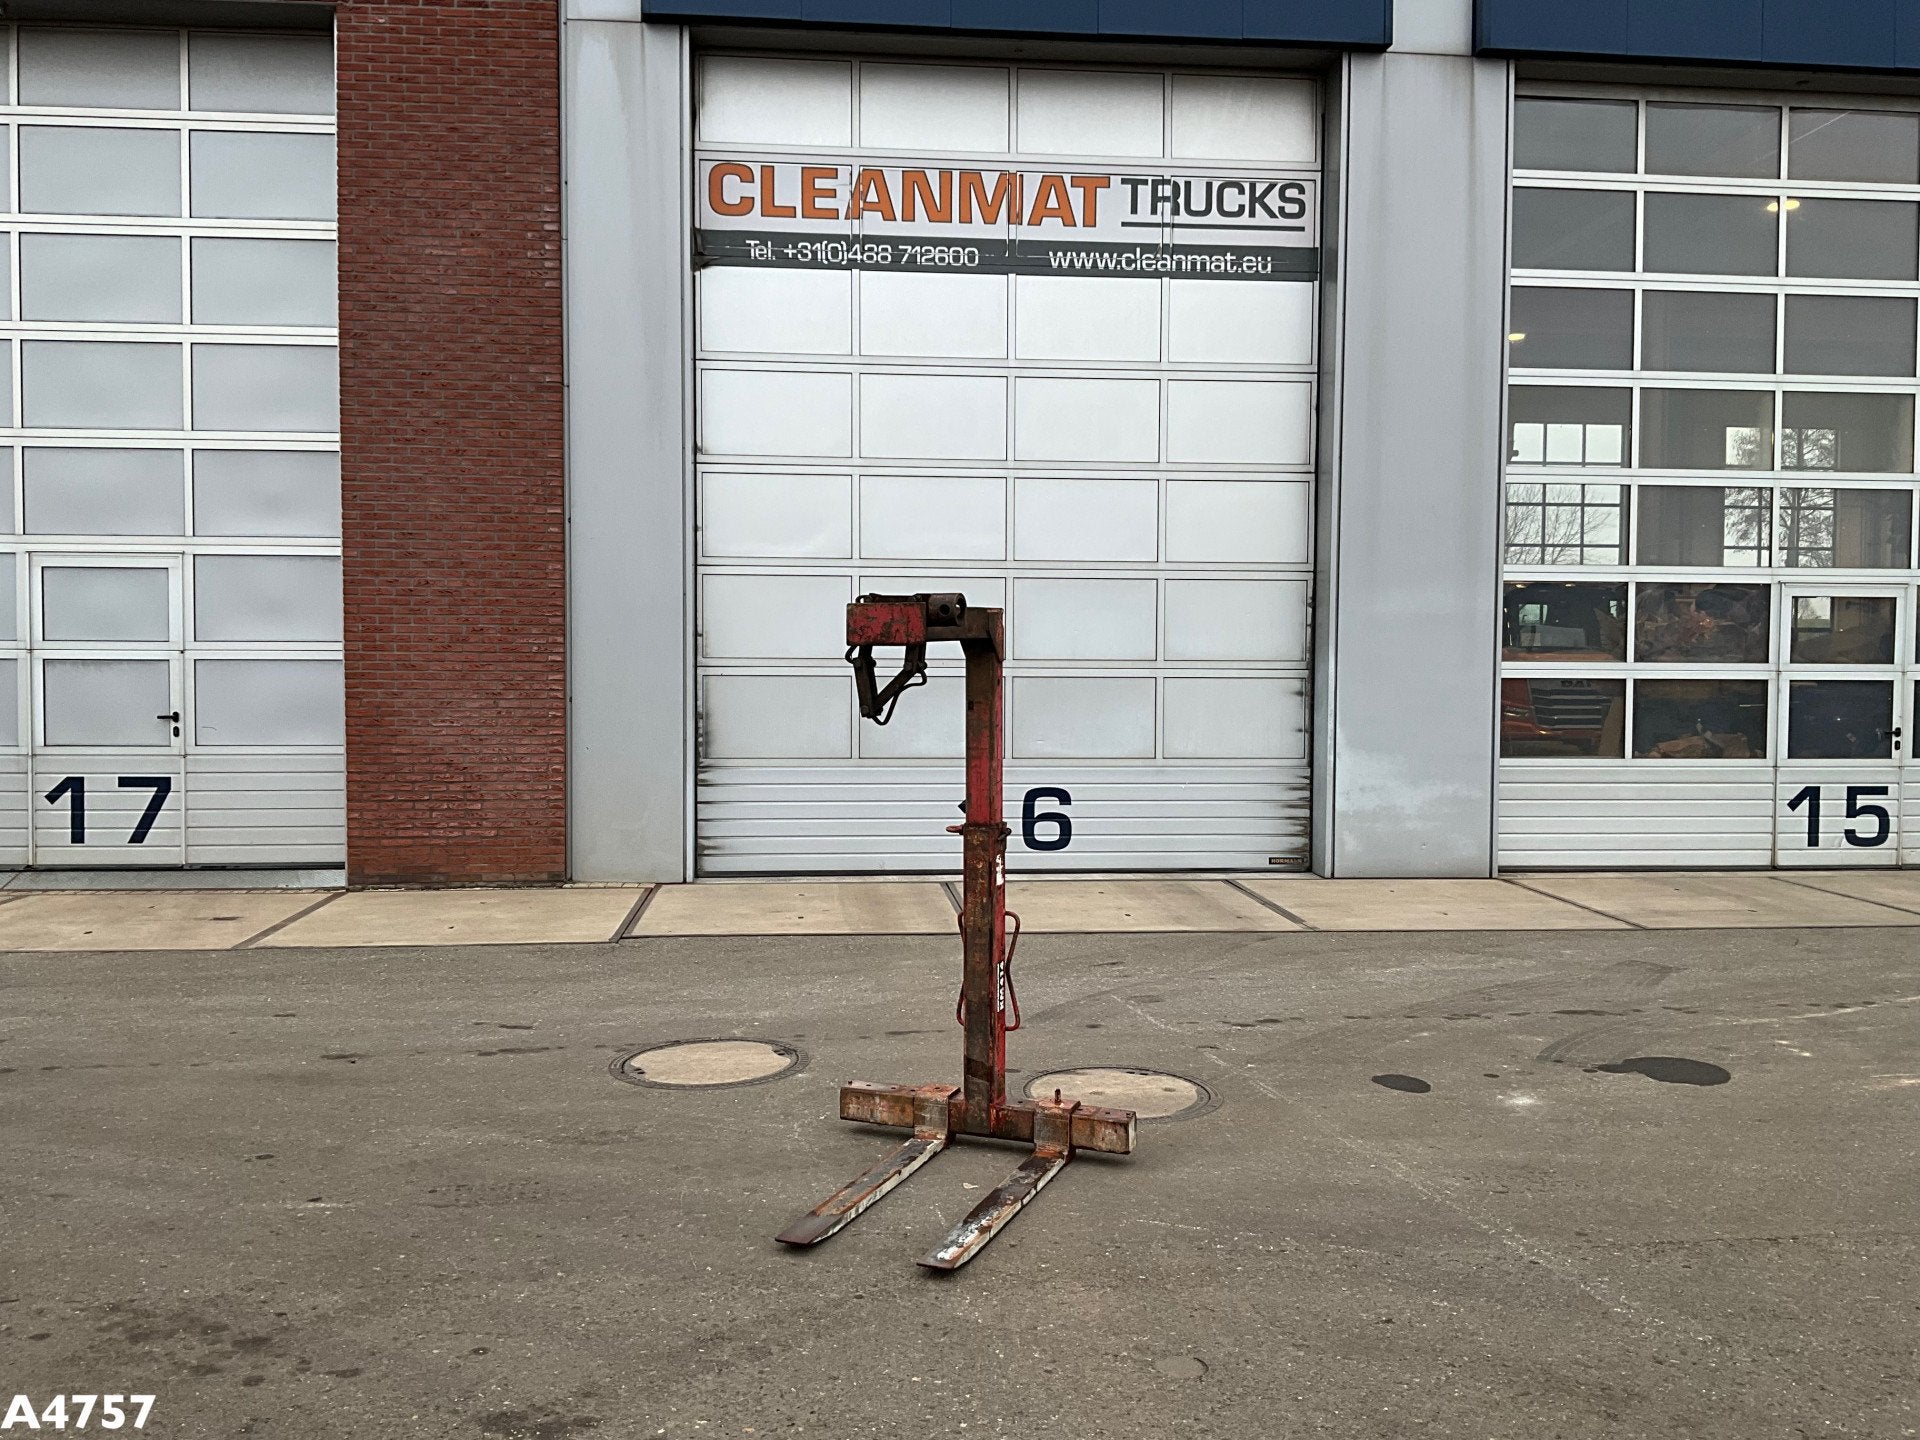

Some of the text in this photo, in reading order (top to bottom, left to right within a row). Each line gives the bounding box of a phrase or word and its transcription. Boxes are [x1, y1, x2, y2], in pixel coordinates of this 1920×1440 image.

[708, 163, 1306, 228] CLEANMAT TRUCKS
[745, 240, 776, 260] Tel.
[898, 245, 979, 267] 712600
[1048, 247, 1272, 274] www.cleanmat.eu
[44, 776, 172, 844] 17
[1786, 786, 1891, 847] 15
